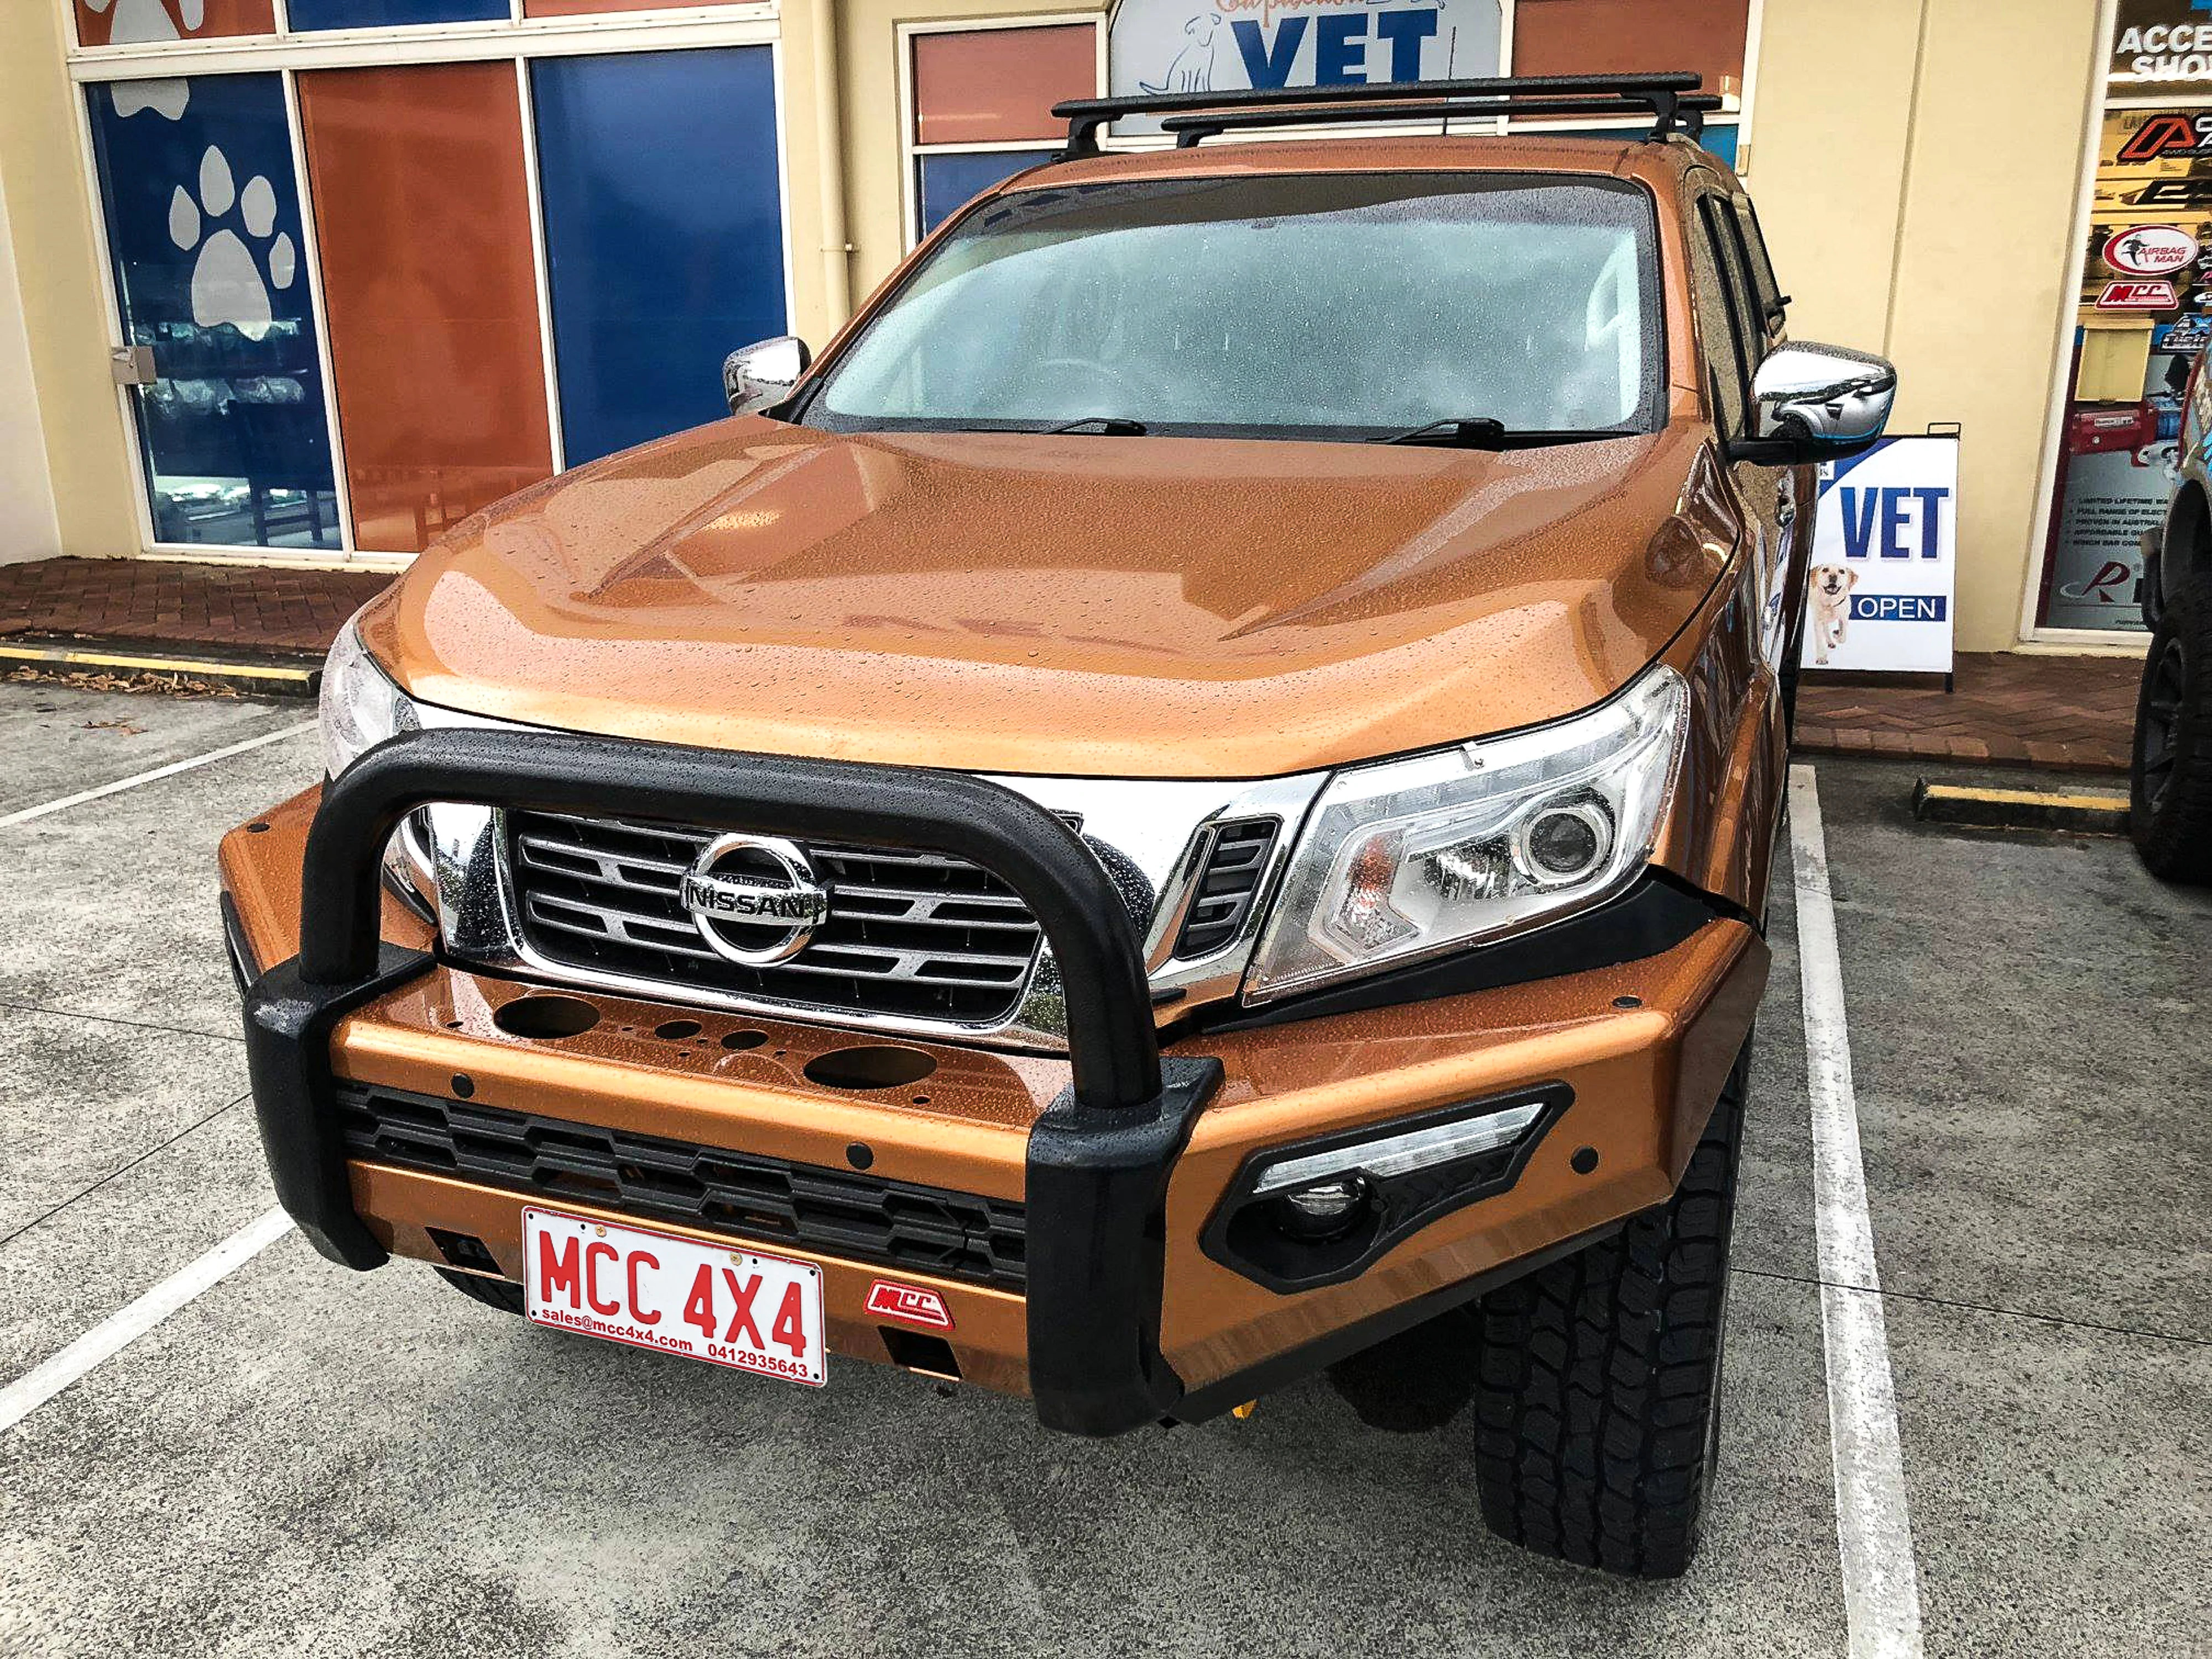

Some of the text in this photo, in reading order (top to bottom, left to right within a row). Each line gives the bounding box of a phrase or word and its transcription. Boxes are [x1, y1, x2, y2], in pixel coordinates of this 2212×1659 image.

[1231, 9, 1437, 91] VET
[2116, 24, 2212, 54] ACCE
[2131, 55, 2212, 82] SHO
[2137, 247, 2187, 255] AIRBAG
[2105, 285, 2168, 302] MCC
[1840, 487, 1949, 559] VET
[1858, 597, 1936, 619] OPEN
[687, 884, 808, 919] NISSAN
[539, 1230, 807, 1358] MCC 4X4
[872, 1286, 943, 1314] MCC
[541, 1307, 808, 1378] sales@mcc4x4.com 0412935643
